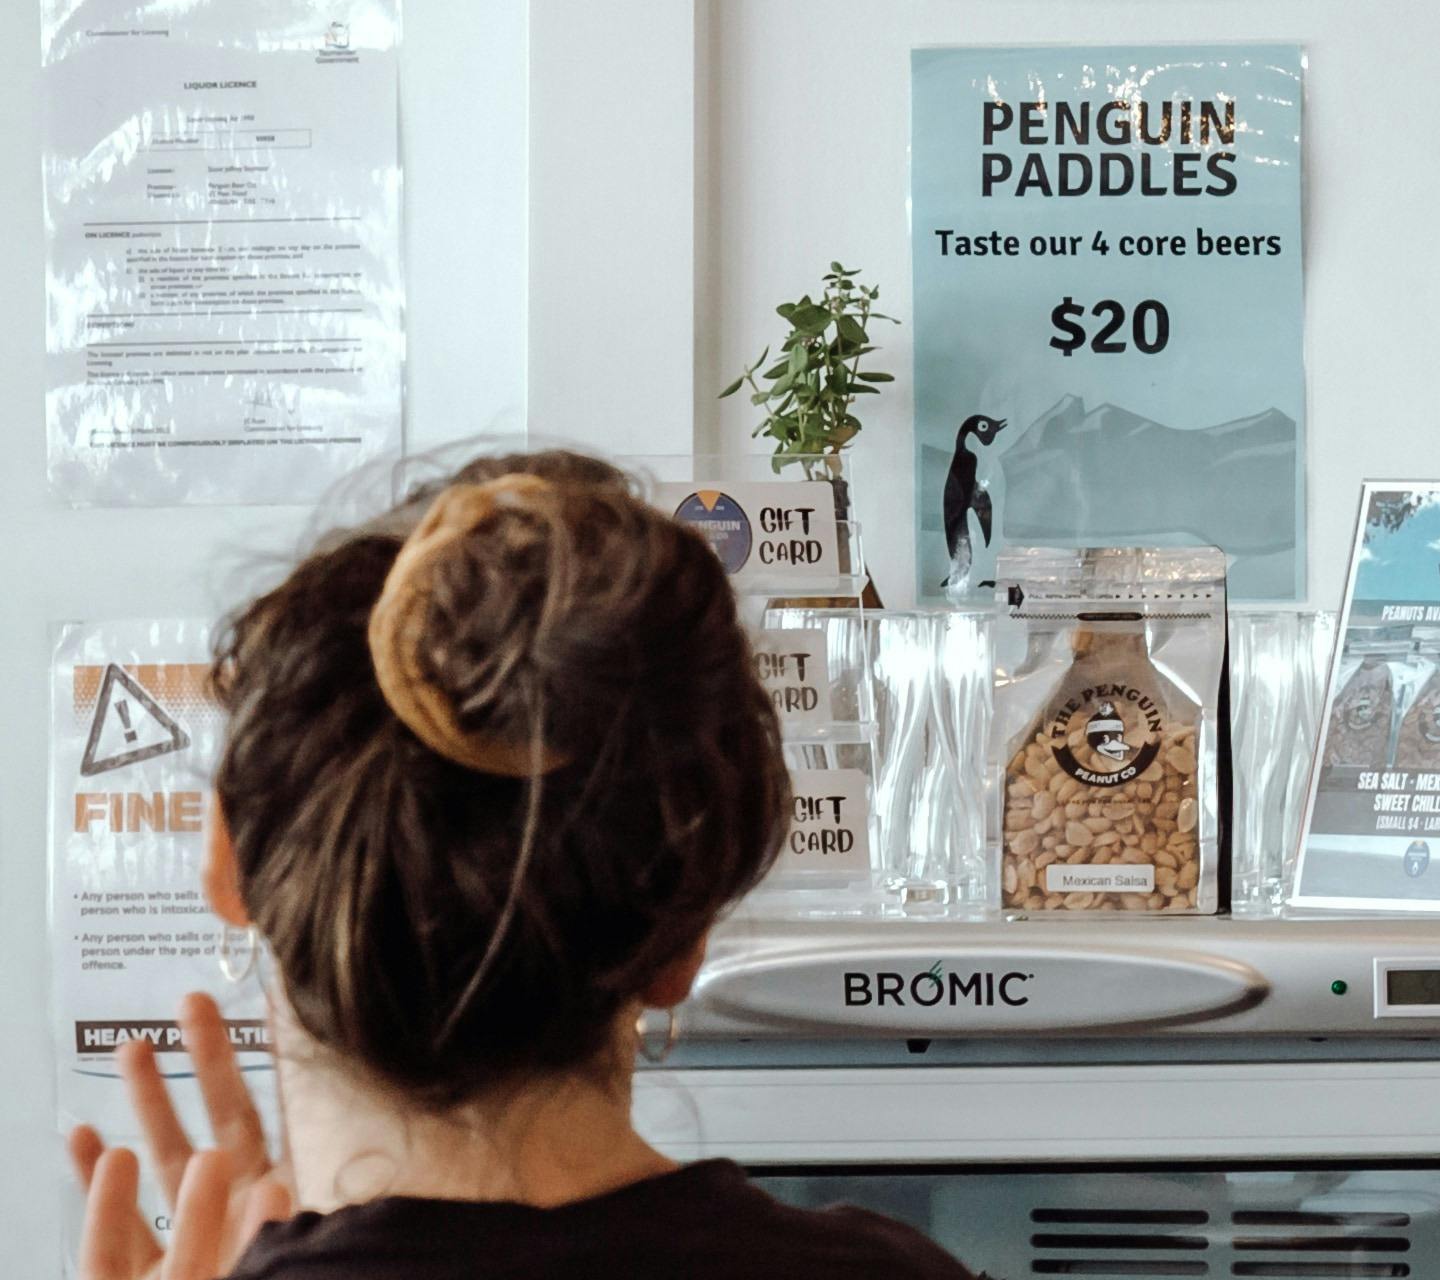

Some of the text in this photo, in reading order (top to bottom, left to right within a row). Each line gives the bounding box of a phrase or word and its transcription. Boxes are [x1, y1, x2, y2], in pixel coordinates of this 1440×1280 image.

[982, 100, 1236, 146] PENGUIN
[981, 152, 1237, 197] PADDLES
[935, 228, 1281, 257] Taste our 4 core beers
[1049, 296, 1170, 357] $20
[759, 507, 816, 535] GIFT
[759, 539, 822, 566] CARD
[1382, 606, 1425, 621] PEANUTS
[1075, 767, 1118, 786] PEANUT
[75, 793, 201, 833] FINE
[1063, 874, 1148, 888] Mexican Salsa
[844, 972, 1029, 1007] BROMIC
